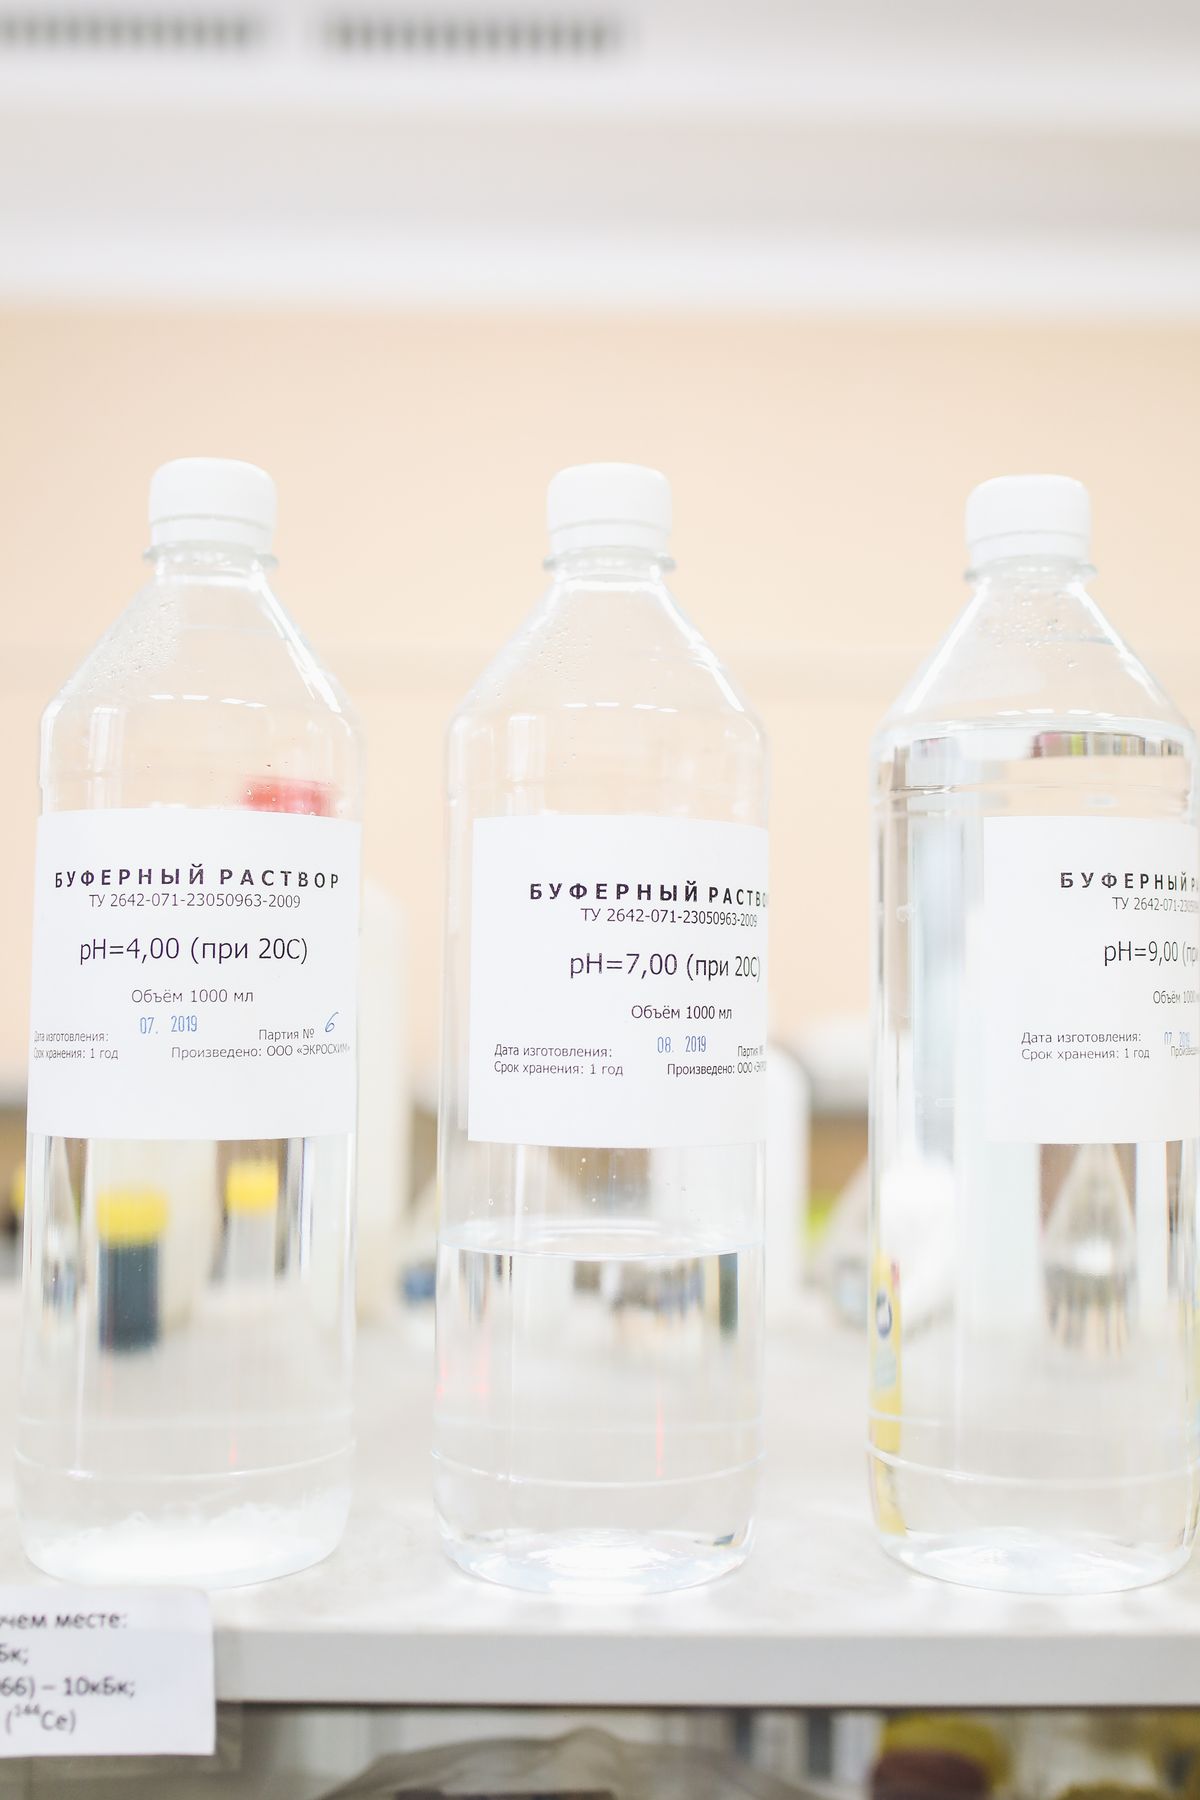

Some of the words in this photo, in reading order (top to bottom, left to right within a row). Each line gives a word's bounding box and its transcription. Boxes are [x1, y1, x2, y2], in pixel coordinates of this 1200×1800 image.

[55, 864, 205, 888] БУФЕРНЫЙ
[220, 869, 339, 888] РАСТВОР
[1061, 872, 1188, 891] БУФЕРНЫЙ
[530, 881, 698, 902] БУФЕРНЫЙ
[89, 894, 106, 908] ТУ
[110, 893, 301, 909] 2642-071-23050963-2009
[1112, 897, 1129, 910] ТУ
[581, 908, 601, 923] ТУ
[607, 908, 758, 928] 2642-071-23050963-2009
[80, 937, 180, 965] pH=4,00
[191, 936, 249, 964] (при
[1104, 940, 1179, 966] pH=9,00
[570, 953, 677, 979] pH=7,00
[686, 953, 729, 981] (при
[131, 989, 183, 1003] Объём
[190, 990, 228, 1003] 1000
[234, 991, 254, 1002] мл
[1153, 991, 1181, 1004] Объём
[631, 1005, 680, 1019] Объём
[686, 1006, 715, 1020] 1000
[719, 1008, 733, 1020] мл
[171, 1015, 198, 1033] 2019
[324, 1011, 339, 1033] 6
[46, 1031, 109, 1043] изготовления:
[258, 1028, 299, 1042] Партия
[303, 1027, 314, 1040] №
[1021, 1032, 1052, 1045] Дата
[1057, 1033, 1142, 1044] изготовления:
[171, 1046, 262, 1060] Произведено:
[266, 1045, 293, 1057] ООО
[494, 1044, 520, 1058] Дата
[523, 1045, 613, 1058] изготовления:
[685, 1036, 707, 1053] 2019
[45, 1047, 86, 1060] хранения:
[90, 1049, 96, 1058] 1
[100, 1049, 119, 1060] год
[1022, 1049, 1052, 1061] Срок
[1057, 1050, 1119, 1061] хранения:
[1125, 1049, 1129, 1059] 1
[1134, 1051, 1150, 1060] год
[494, 1061, 520, 1074] Срок
[523, 1062, 585, 1075] хранения:
[590, 1064, 596, 1075] 1
[602, 1065, 624, 1077] год
[667, 1063, 735, 1077] Произведено:
[737, 1062, 753, 1074] ООО
[55, 1613, 128, 1629] месте:
